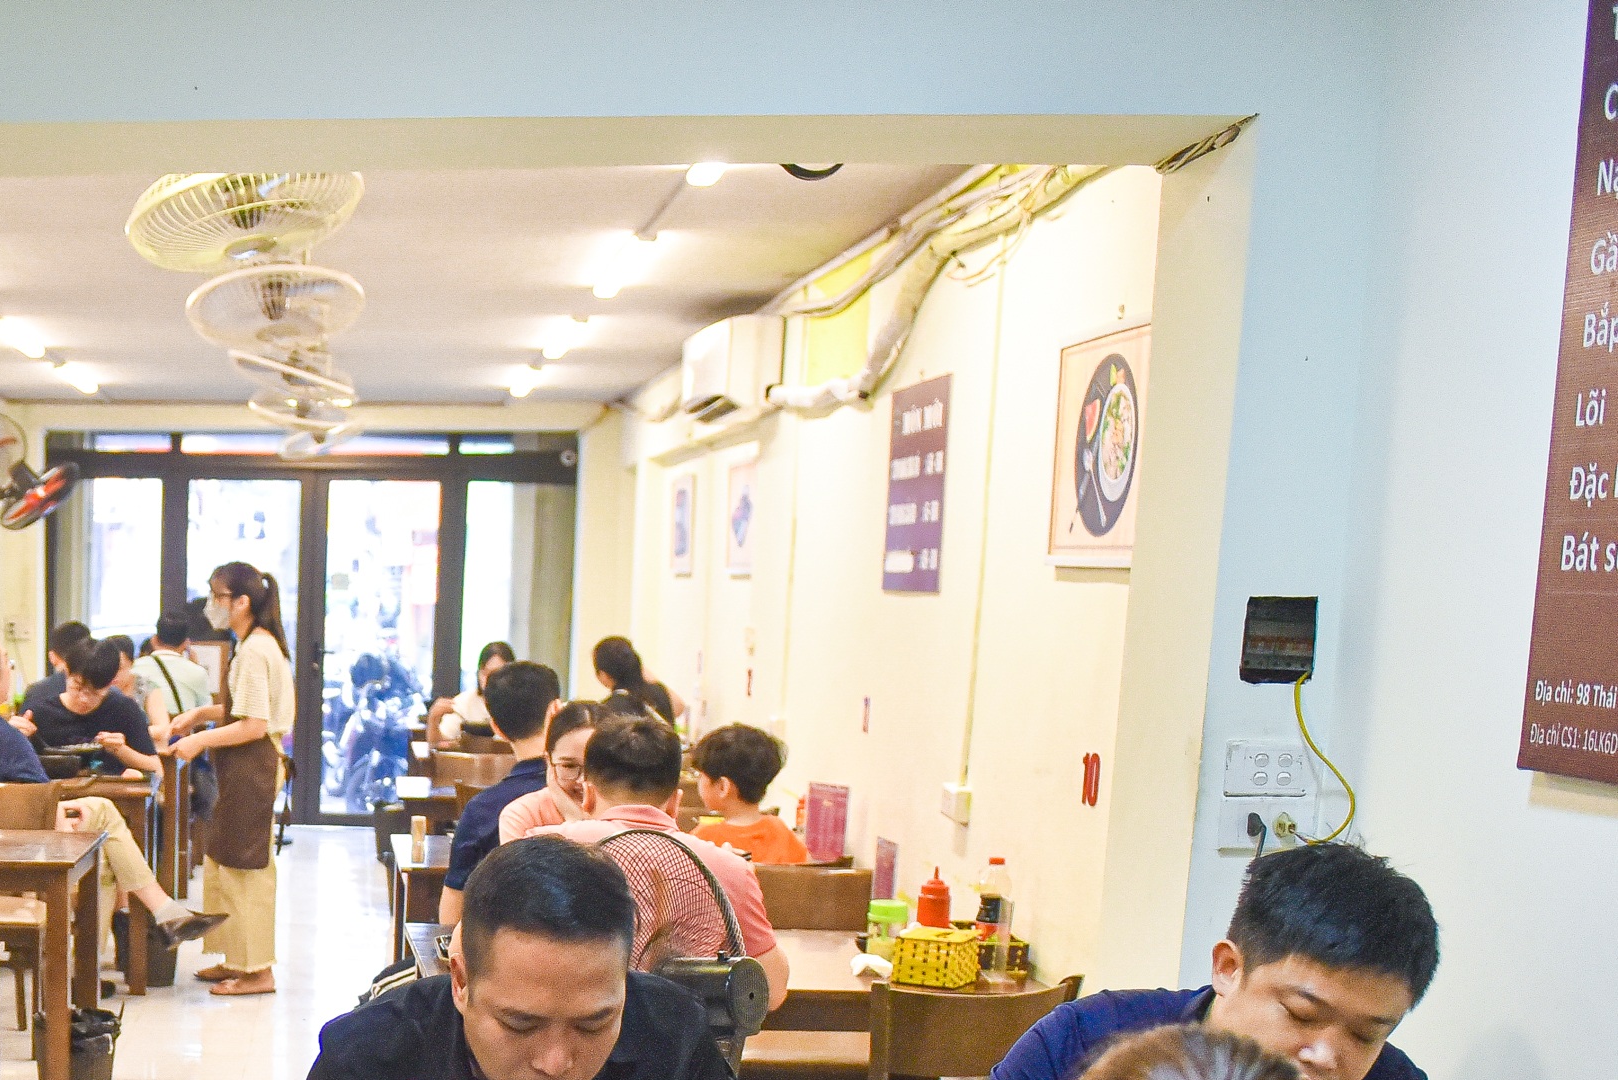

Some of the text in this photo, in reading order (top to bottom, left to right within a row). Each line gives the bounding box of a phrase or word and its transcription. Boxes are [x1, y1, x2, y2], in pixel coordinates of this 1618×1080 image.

[1583, 301, 1618, 353] Bắp
[1575, 388, 1606, 426] Lõi
[1569, 462, 1609, 507] Đặc
[1560, 531, 1618, 572] Bát s
[1535, 679, 1618, 709] Địa chỉ: 98 Thái
[1530, 723, 1545, 747] Địa
[1546, 722, 1561, 746] chỉ
[1561, 726, 1581, 749] CS1:
[1082, 752, 1100, 807] 10
